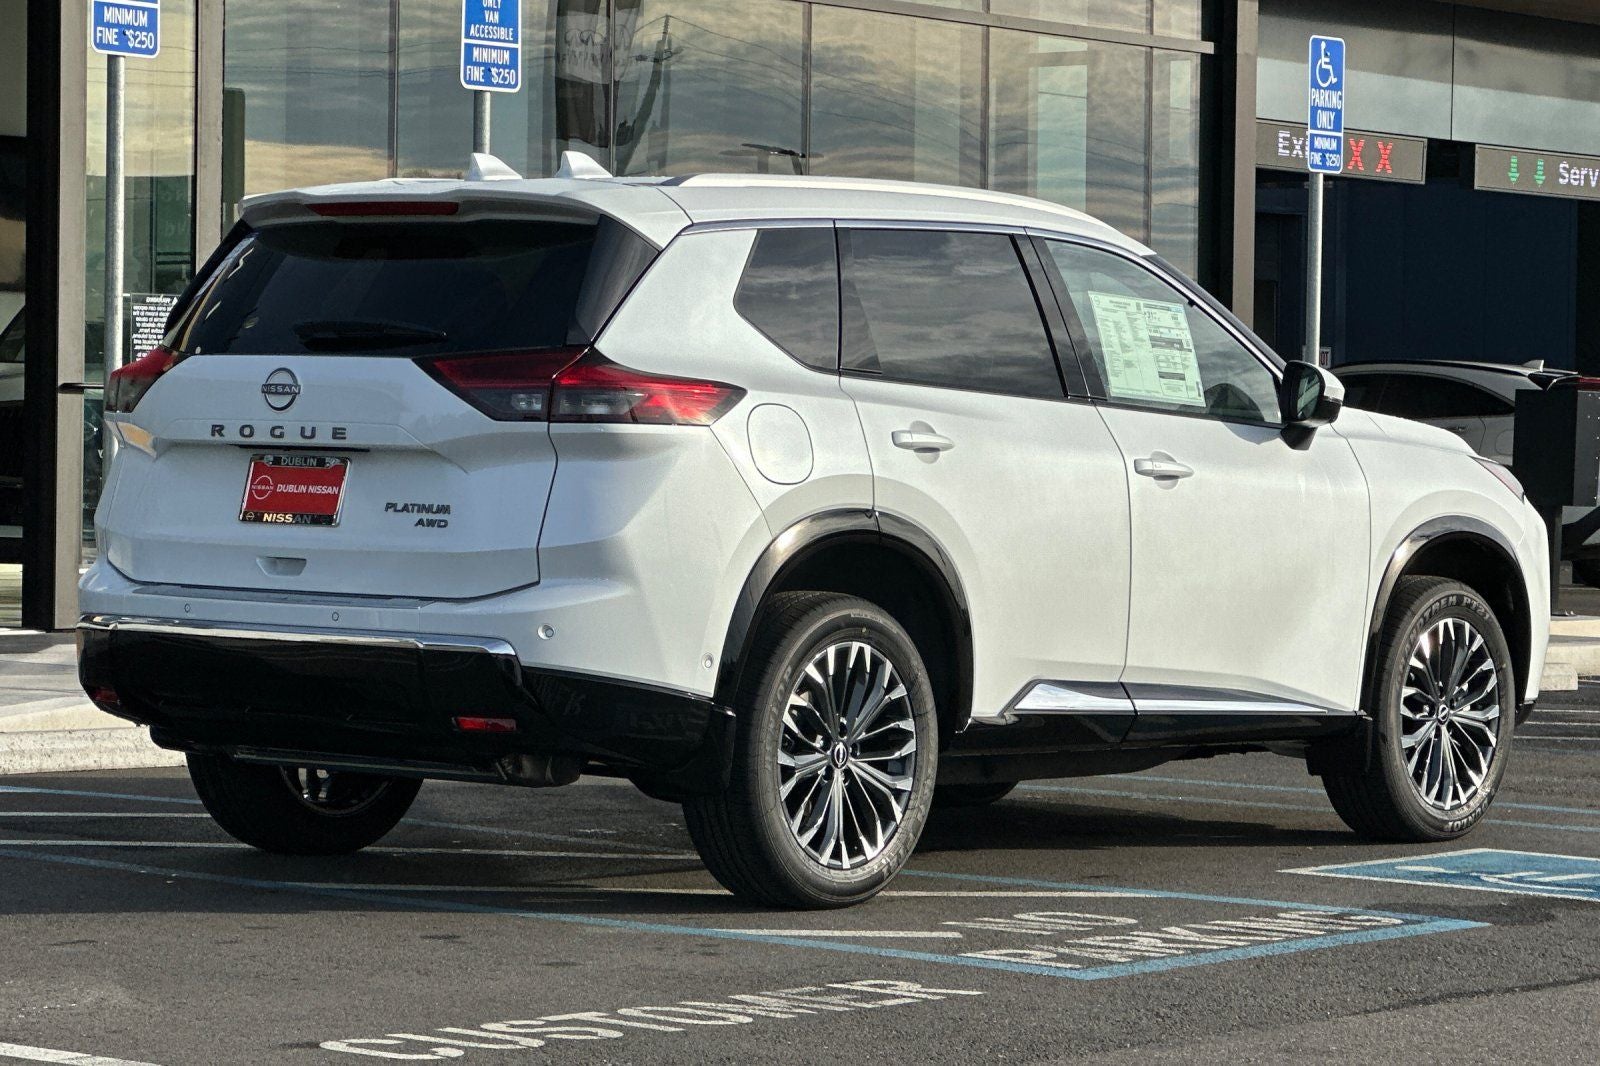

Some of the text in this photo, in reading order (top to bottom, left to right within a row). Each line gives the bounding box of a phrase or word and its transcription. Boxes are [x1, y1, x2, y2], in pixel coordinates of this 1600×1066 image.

[482, 0, 501, 9] ONLY
[103, 6, 148, 27] MINIMUM
[484, 10, 499, 24] VAN
[96, 26, 155, 49] FINE $250
[469, 24, 514, 40] ACCESSIBLE
[472, 46, 510, 65] MINIMUM
[466, 65, 516, 85] FINE $250
[1311, 88, 1342, 110] PARKING
[1316, 110, 1336, 129] ONLY
[1313, 136, 1338, 151] MINIMUM
[1310, 152, 1323, 166] FINE
[261, 384, 300, 394] NISSAN
[210, 424, 347, 440] ROGUE
[281, 456, 317, 467] DUBLIN
[276, 483, 339, 495] DUBLIN NISSAN
[384, 502, 451, 514] PLATINUM
[263, 513, 312, 523] NISSAN
[414, 518, 449, 528] AWD
[1444, 797, 1488, 832] DUNLOP
[941, 911, 1138, 935] NO
[956, 911, 1405, 969] PARKING
[318, 979, 987, 1060] CUSTOMER
